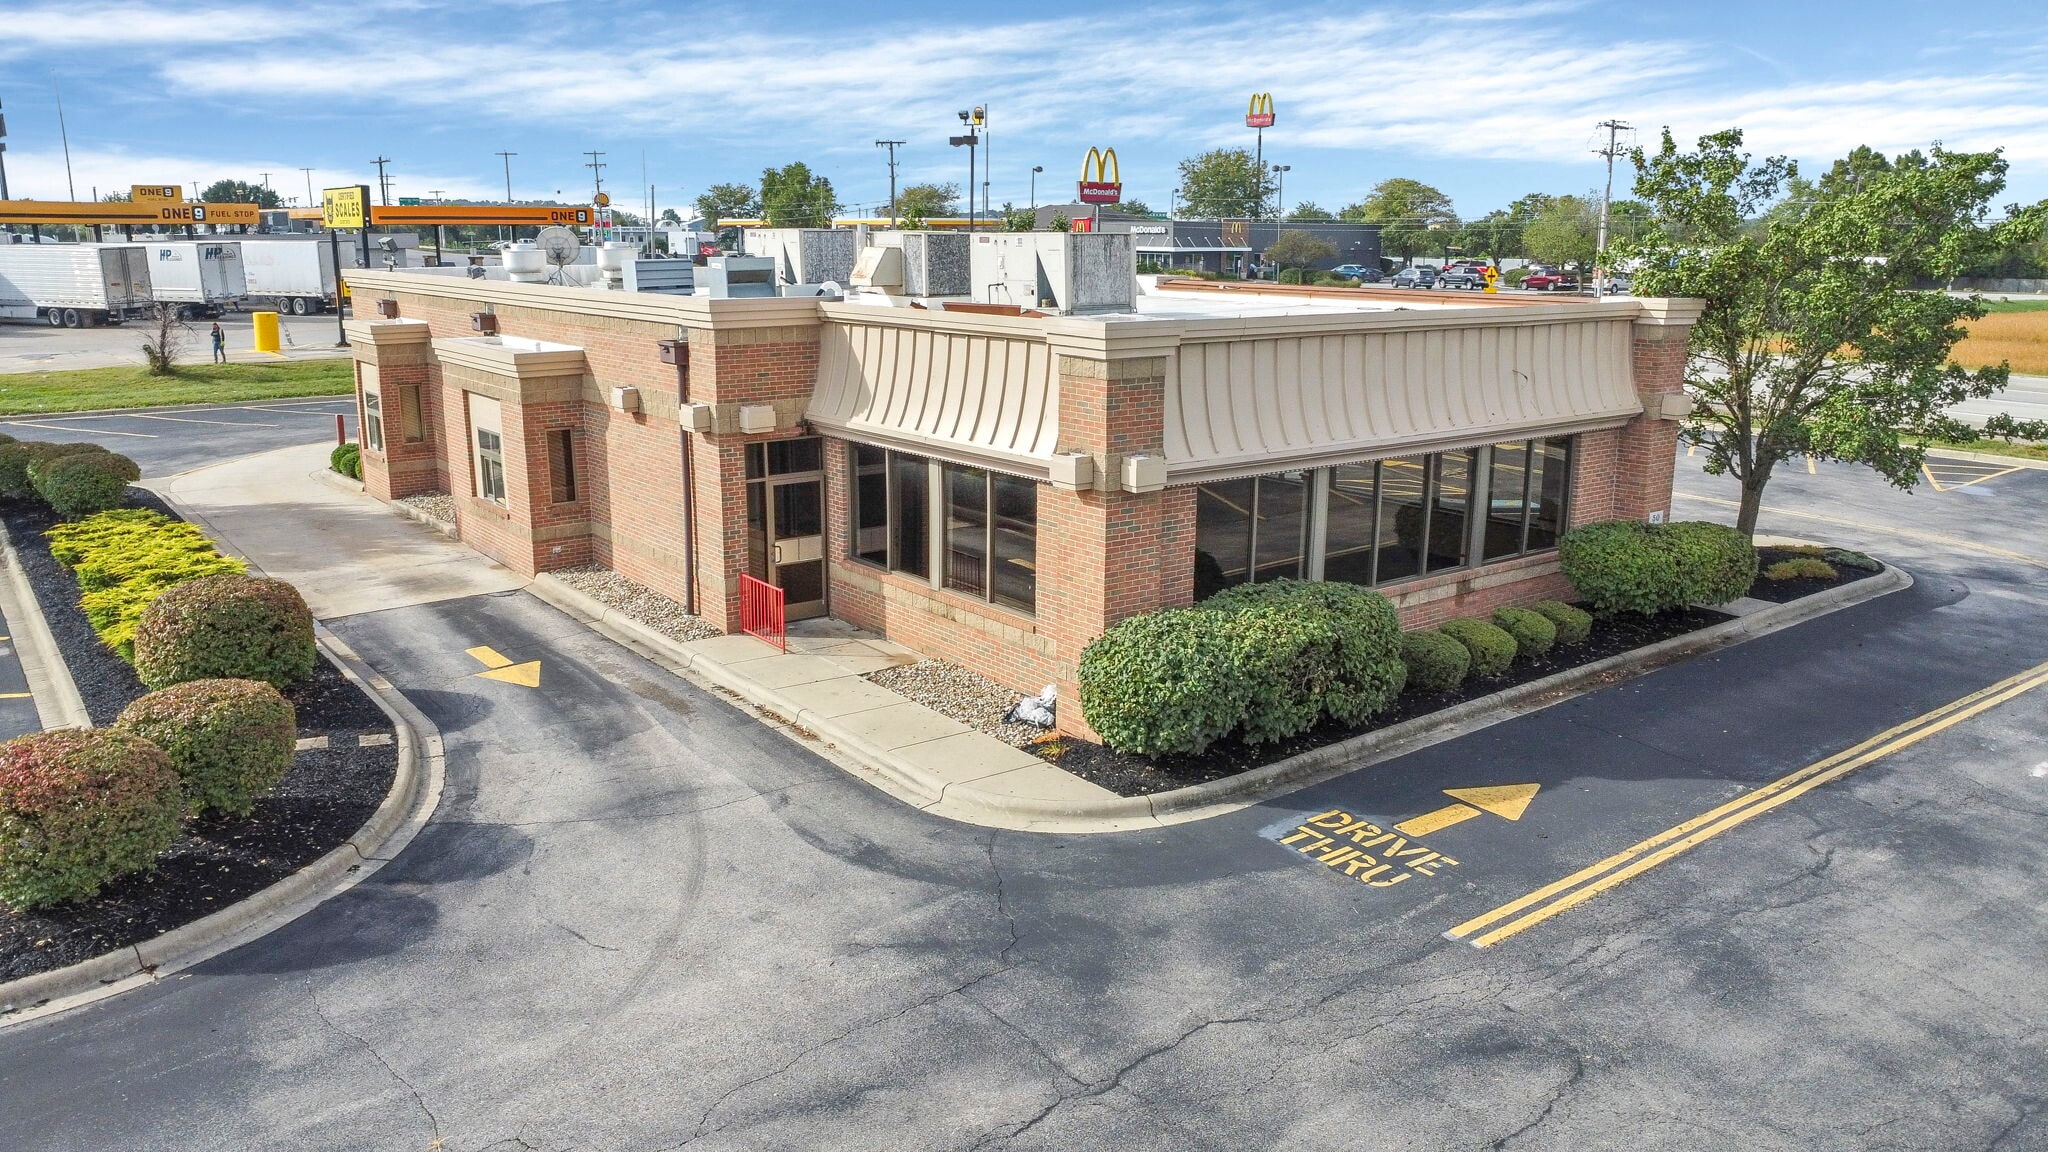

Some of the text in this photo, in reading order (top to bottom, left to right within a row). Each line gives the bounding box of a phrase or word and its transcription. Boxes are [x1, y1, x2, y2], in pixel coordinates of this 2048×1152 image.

[1083, 188, 1118, 196] McDonald's
[335, 202, 360, 218] SCALES
[1130, 226, 1166, 234] McDonald's
[1306, 809, 1460, 877] DRIVE
[1279, 825, 1412, 887] THRU
